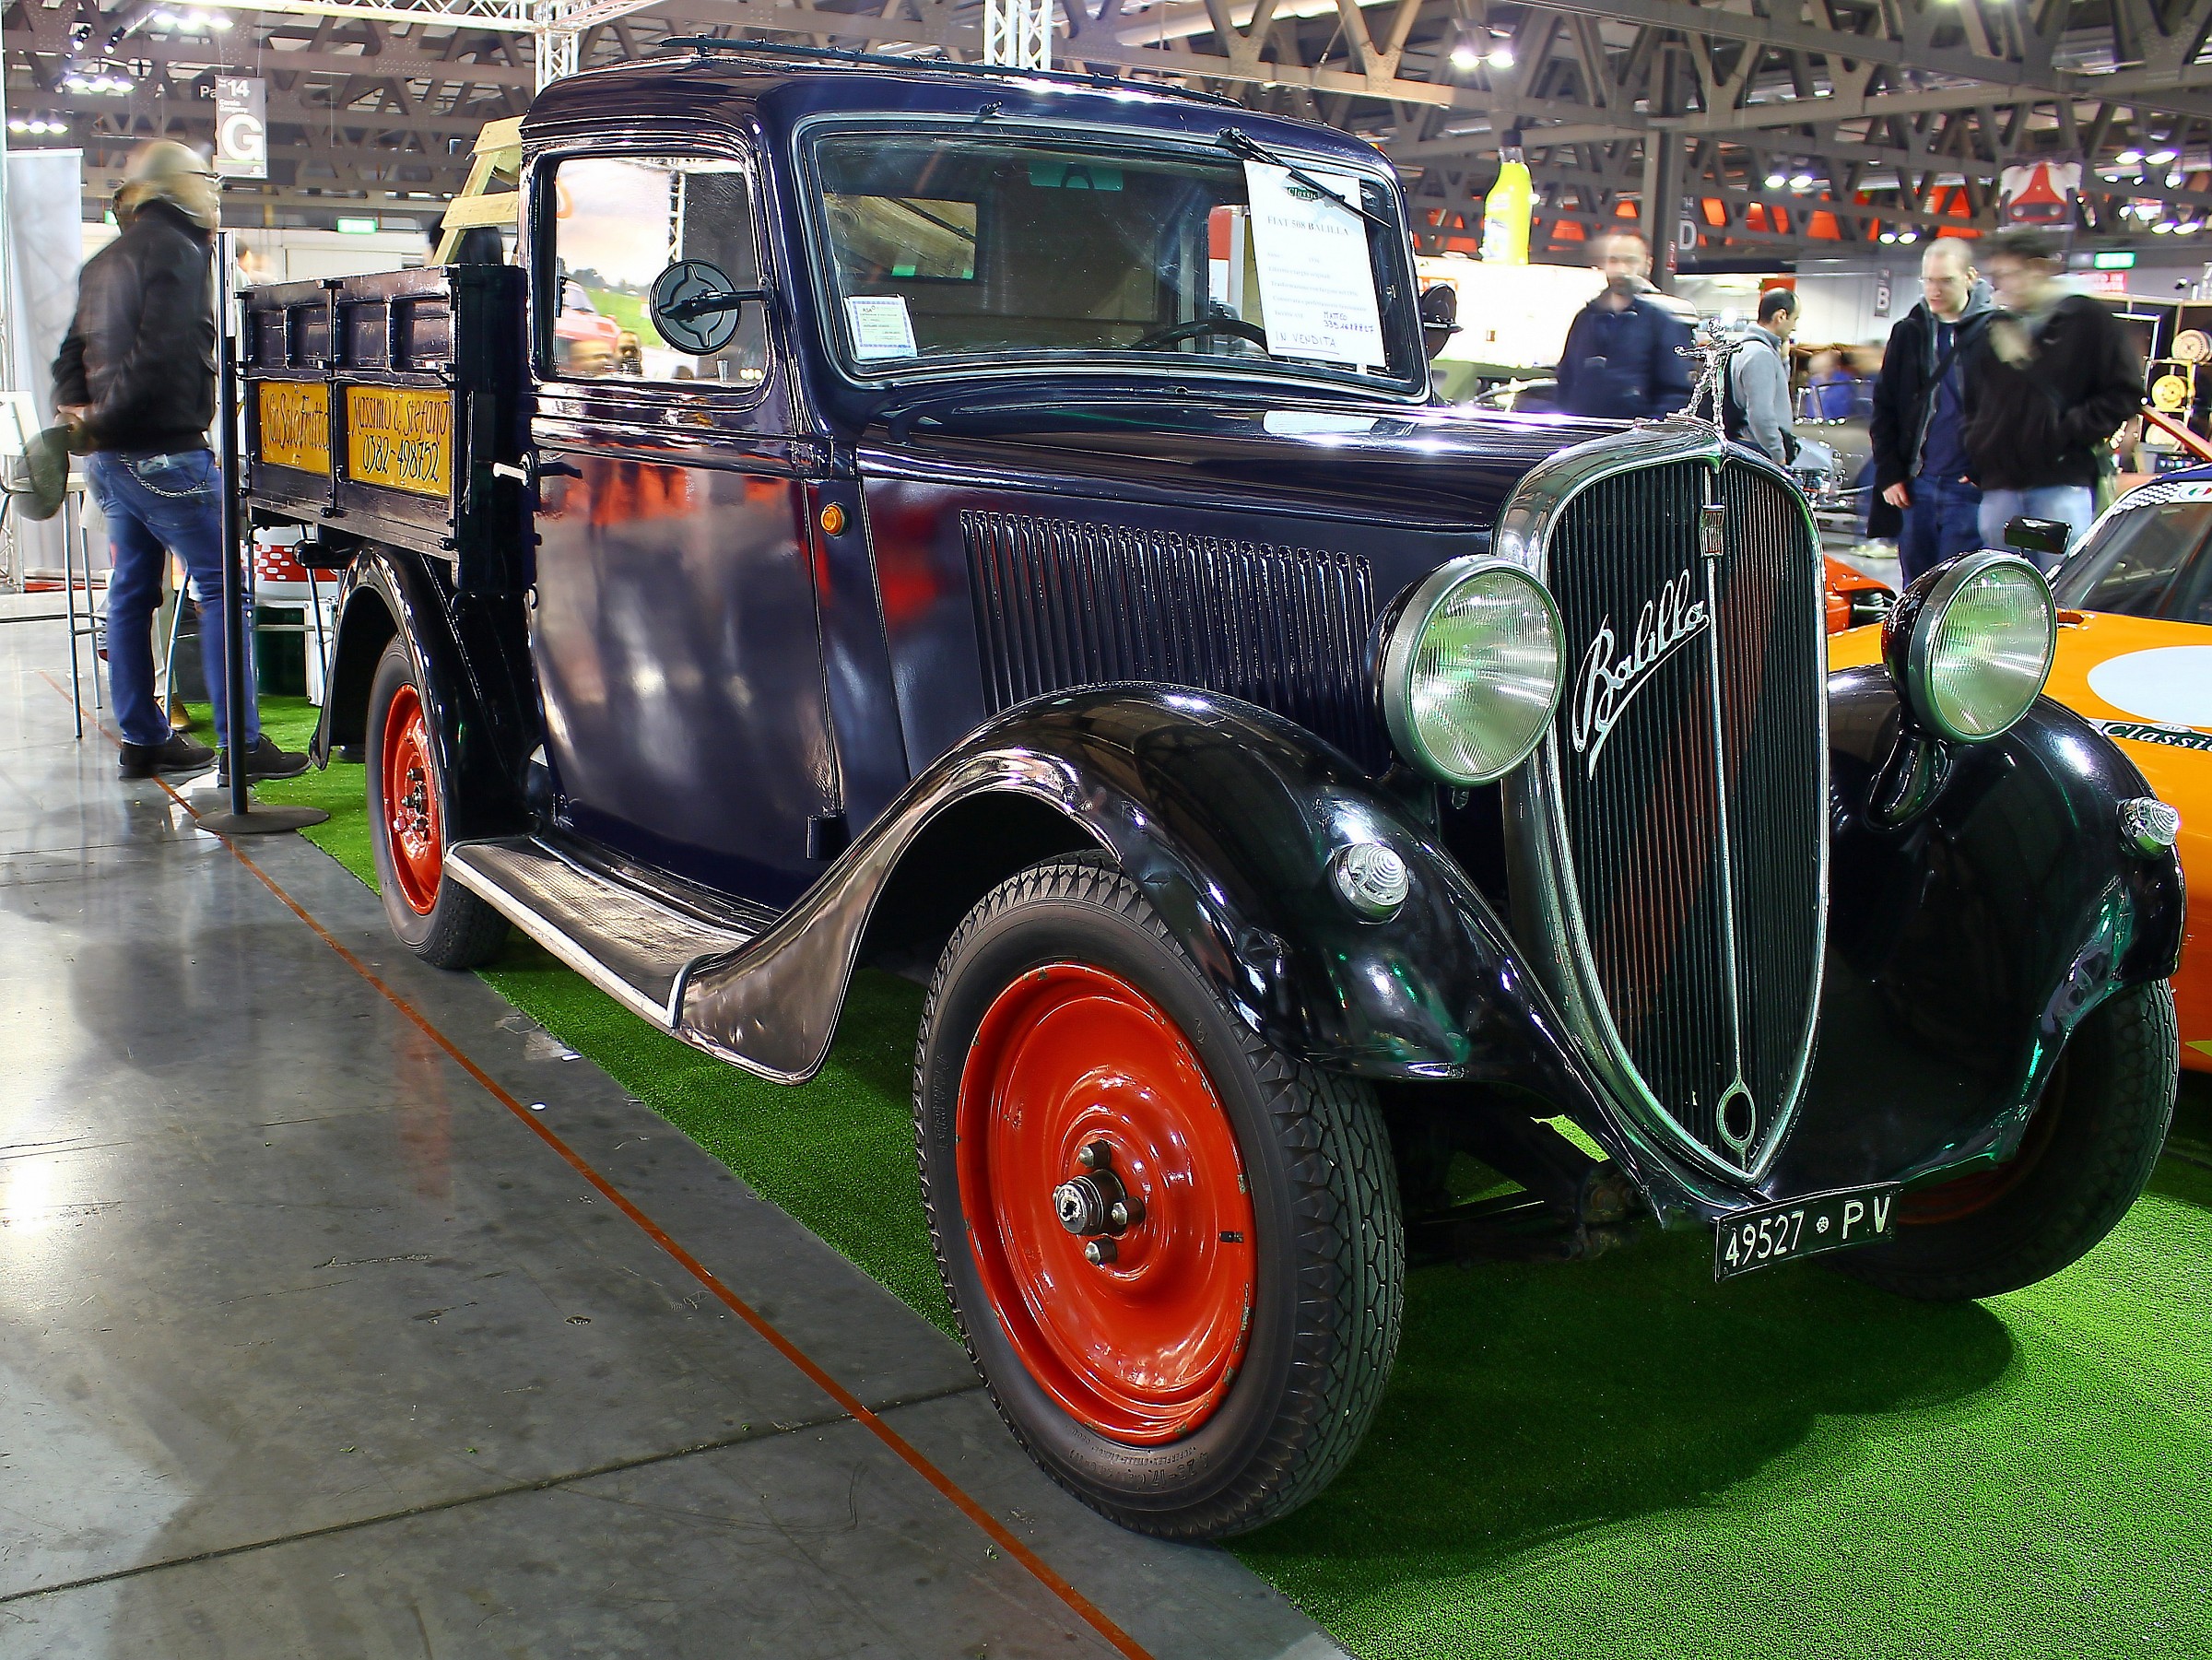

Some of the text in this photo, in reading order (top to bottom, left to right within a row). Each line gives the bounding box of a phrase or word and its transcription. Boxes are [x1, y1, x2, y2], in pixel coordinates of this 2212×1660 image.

[221, 113, 265, 161] G
[1287, 186, 1319, 200] Classic
[1267, 216, 1349, 236] FIAT 508 BALILLA
[1679, 219, 1697, 250] D
[1877, 287, 1889, 309] B
[1324, 312, 1347, 321] MATTEO
[1275, 331, 1336, 347] IN VENDITA
[1572, 569, 1710, 780] Balilla
[1725, 1210, 1805, 1267] 49527
